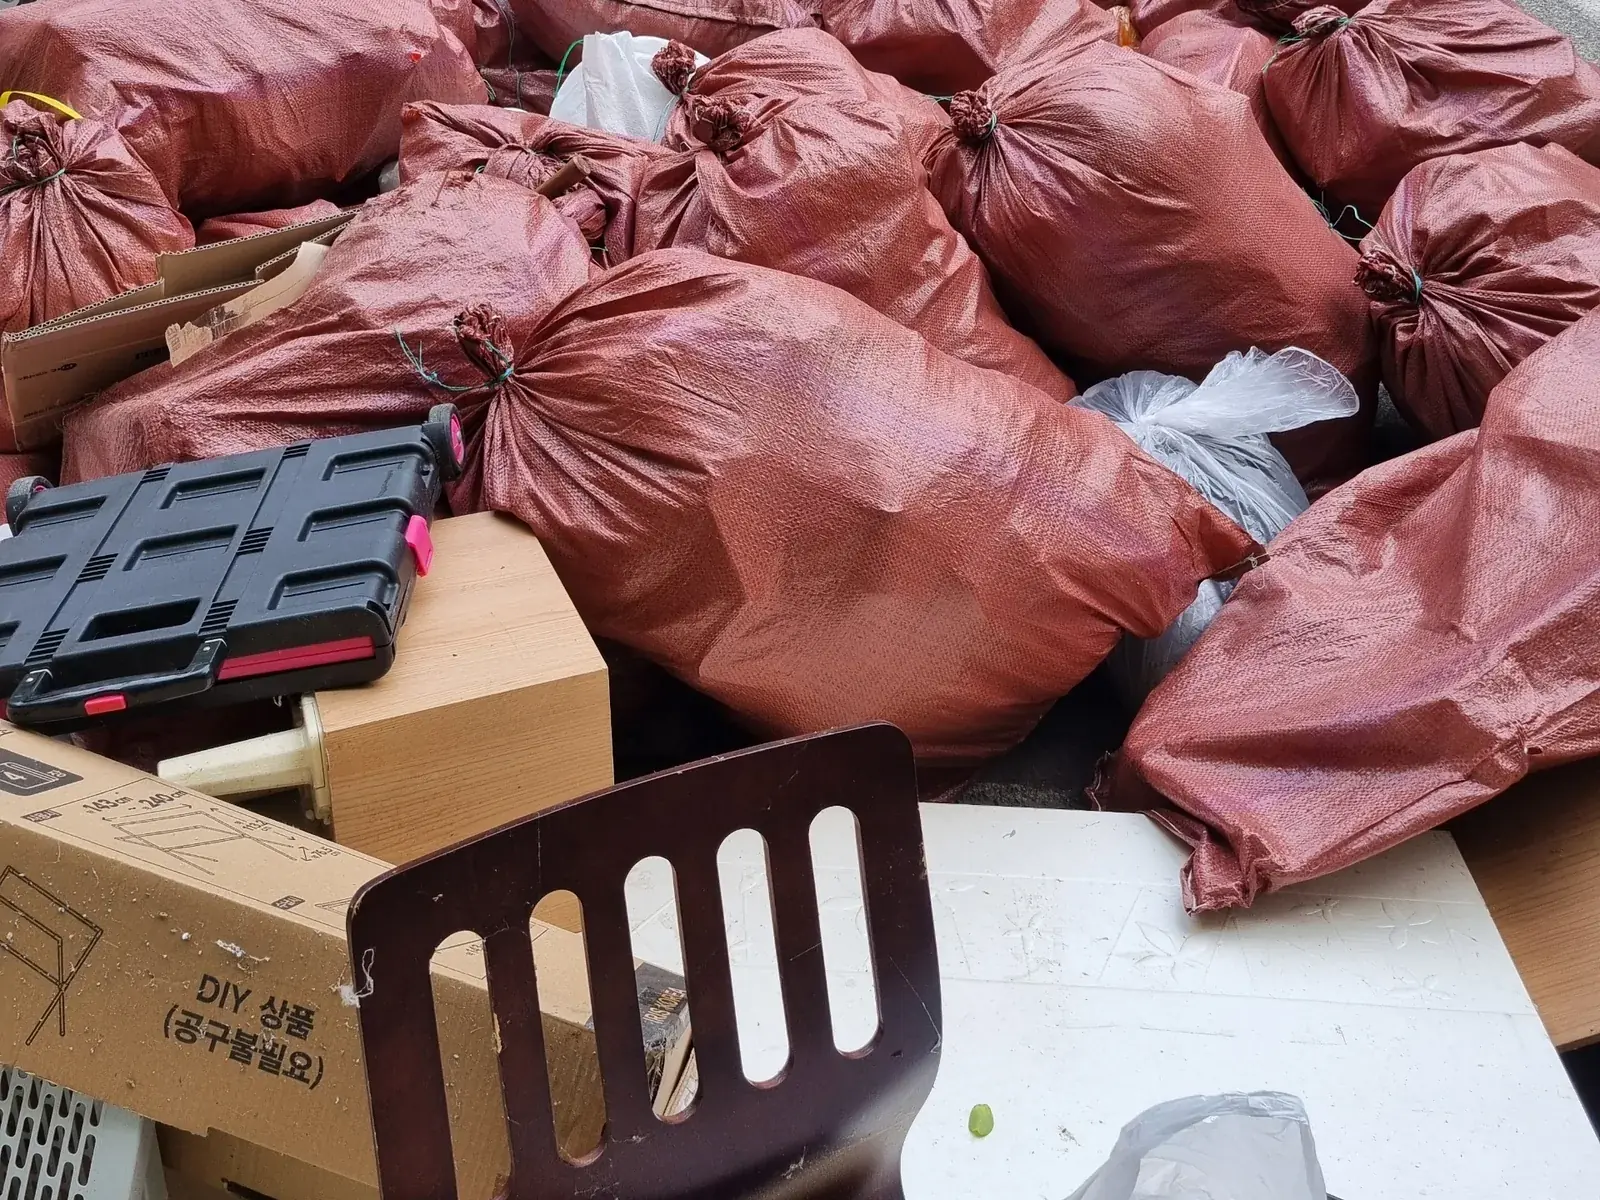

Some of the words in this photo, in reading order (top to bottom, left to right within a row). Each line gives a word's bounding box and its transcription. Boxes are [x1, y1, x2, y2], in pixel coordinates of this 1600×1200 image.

[196, 974, 252, 1013] DIY
[259, 996, 315, 1041] 상품
[643, 1007, 670, 1024] IRIS
[654, 987, 687, 1011] KOREA
[164, 1004, 323, 1090] (공구불필요)
